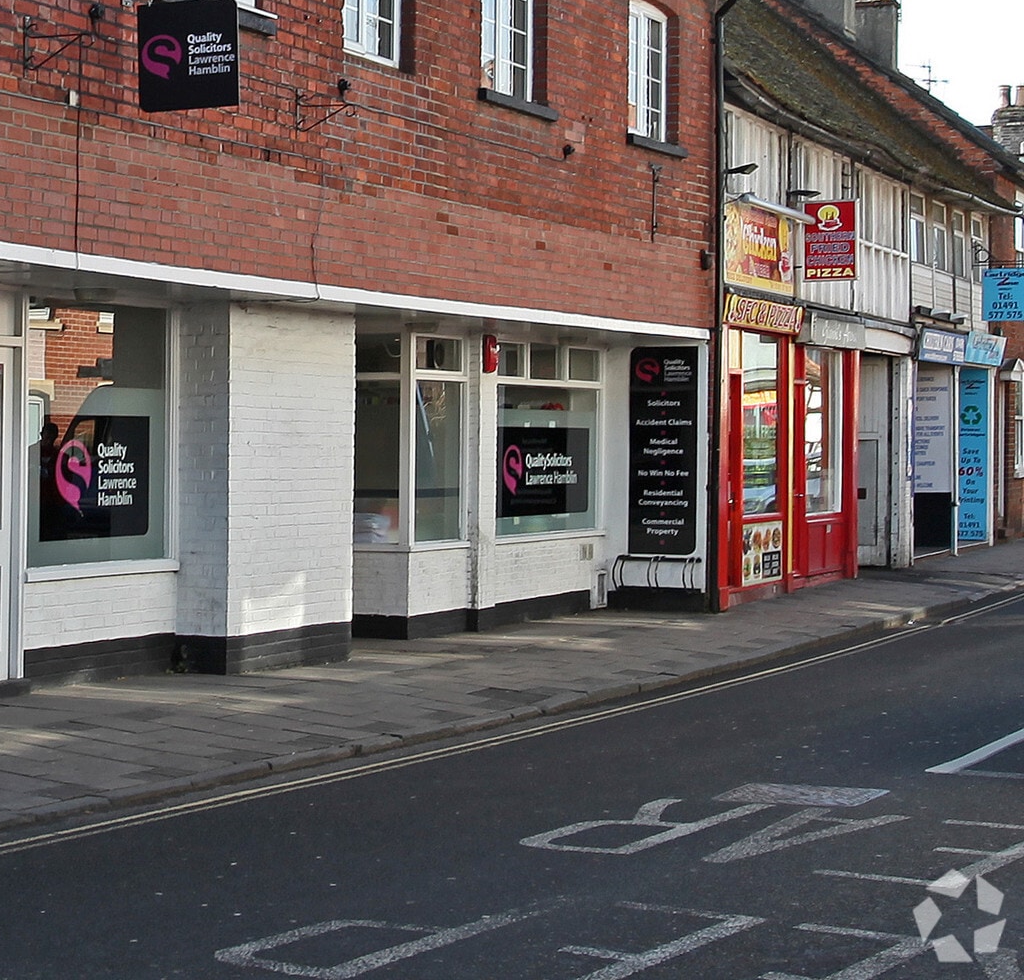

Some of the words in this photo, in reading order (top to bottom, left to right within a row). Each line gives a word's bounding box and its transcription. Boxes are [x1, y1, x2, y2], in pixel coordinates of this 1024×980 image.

[187, 32, 223, 45] Quality
[188, 43, 232, 55] Solicitors
[188, 53, 236, 66] Lawrence
[188, 63, 231, 76] Hamblin
[809, 242, 851, 254] FRIED
[806, 253, 854, 266] CHICKEN
[806, 267, 854, 278] PIZZA
[997, 292, 1013, 300] Tel:
[736, 299, 758, 323] SFC
[992, 301, 1018, 309] 01491
[988, 310, 1004, 319] 577
[1006, 310, 1023, 319] 575
[97, 442, 127, 461] Quality
[643, 448, 684, 456] Negligence
[962, 447, 980, 455] Save
[98, 458, 135, 475] Solicitors
[525, 452, 573, 471] QualitySolicitors
[960, 457, 971, 465] Up
[958, 466, 984, 477] 60%
[98, 475, 137, 490] Lawrence
[525, 471, 553, 486] Lawrence
[553, 470, 578, 485] Hamblin
[97, 491, 133, 506] Hamblin
[638, 499, 688, 508] Conveyancing
[646, 528, 679, 536] Property
